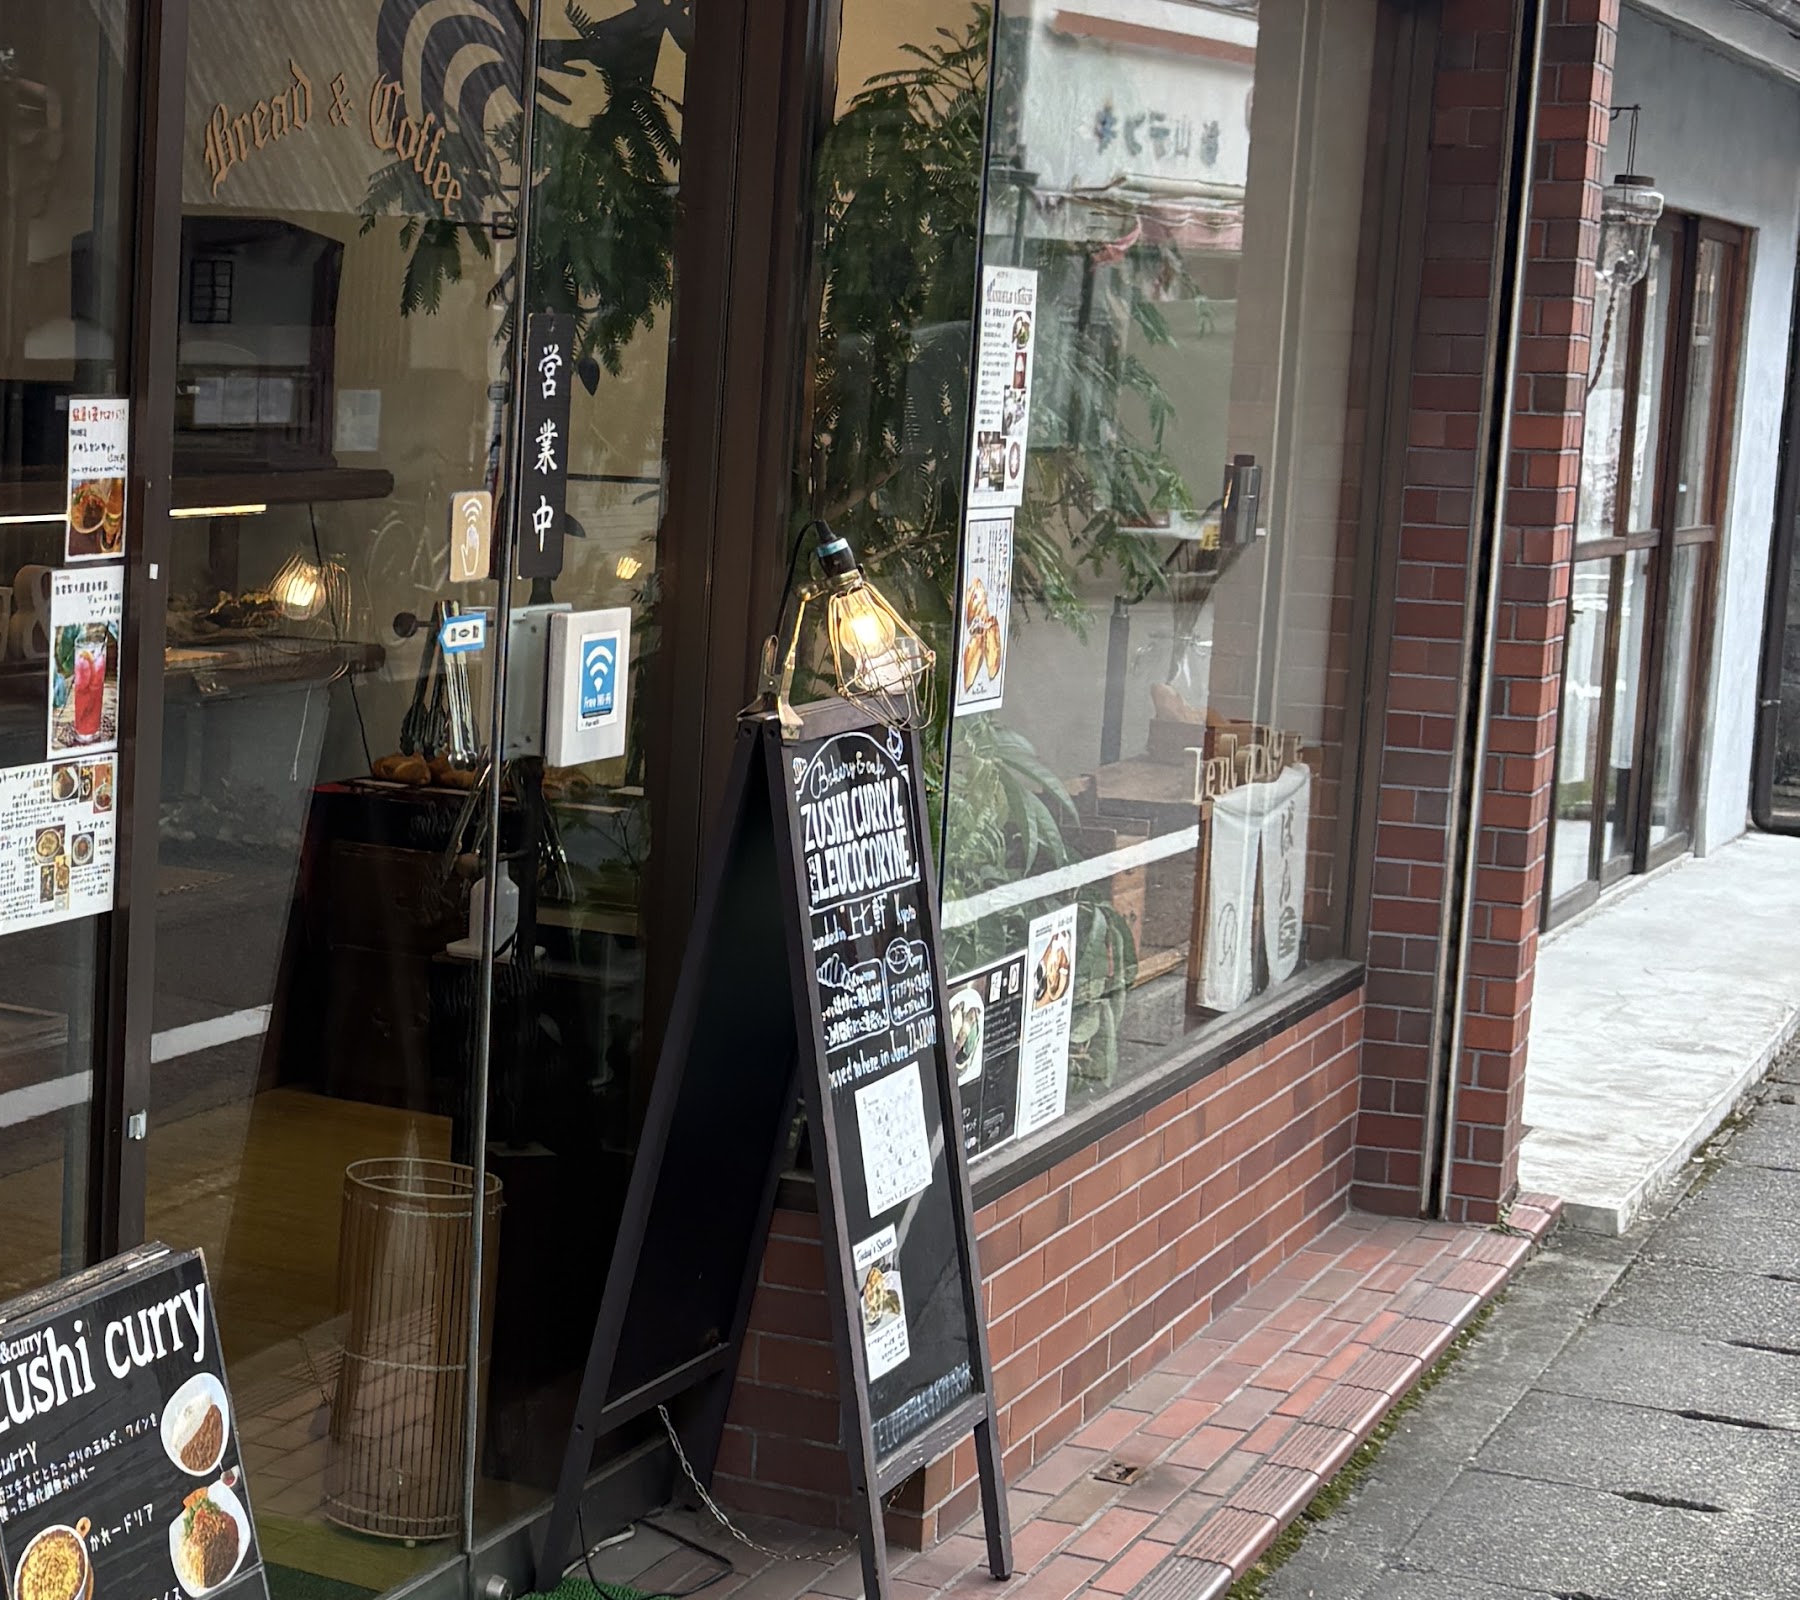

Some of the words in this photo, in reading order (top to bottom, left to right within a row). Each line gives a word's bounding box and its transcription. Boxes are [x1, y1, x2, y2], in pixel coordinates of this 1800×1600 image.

[205, 58, 313, 199] Bread
[328, 72, 353, 127] &
[369, 73, 462, 217] Coffee
[532, 345, 562, 552] 営業中
[801, 791, 854, 852] ZUSHI
[852, 778, 893, 837] CURRY
[891, 776, 905, 827] &
[814, 827, 912, 900] LEUCOCORYNE
[105, 1282, 205, 1379] curry
[90, 1503, 153, 1552] かれードリア
